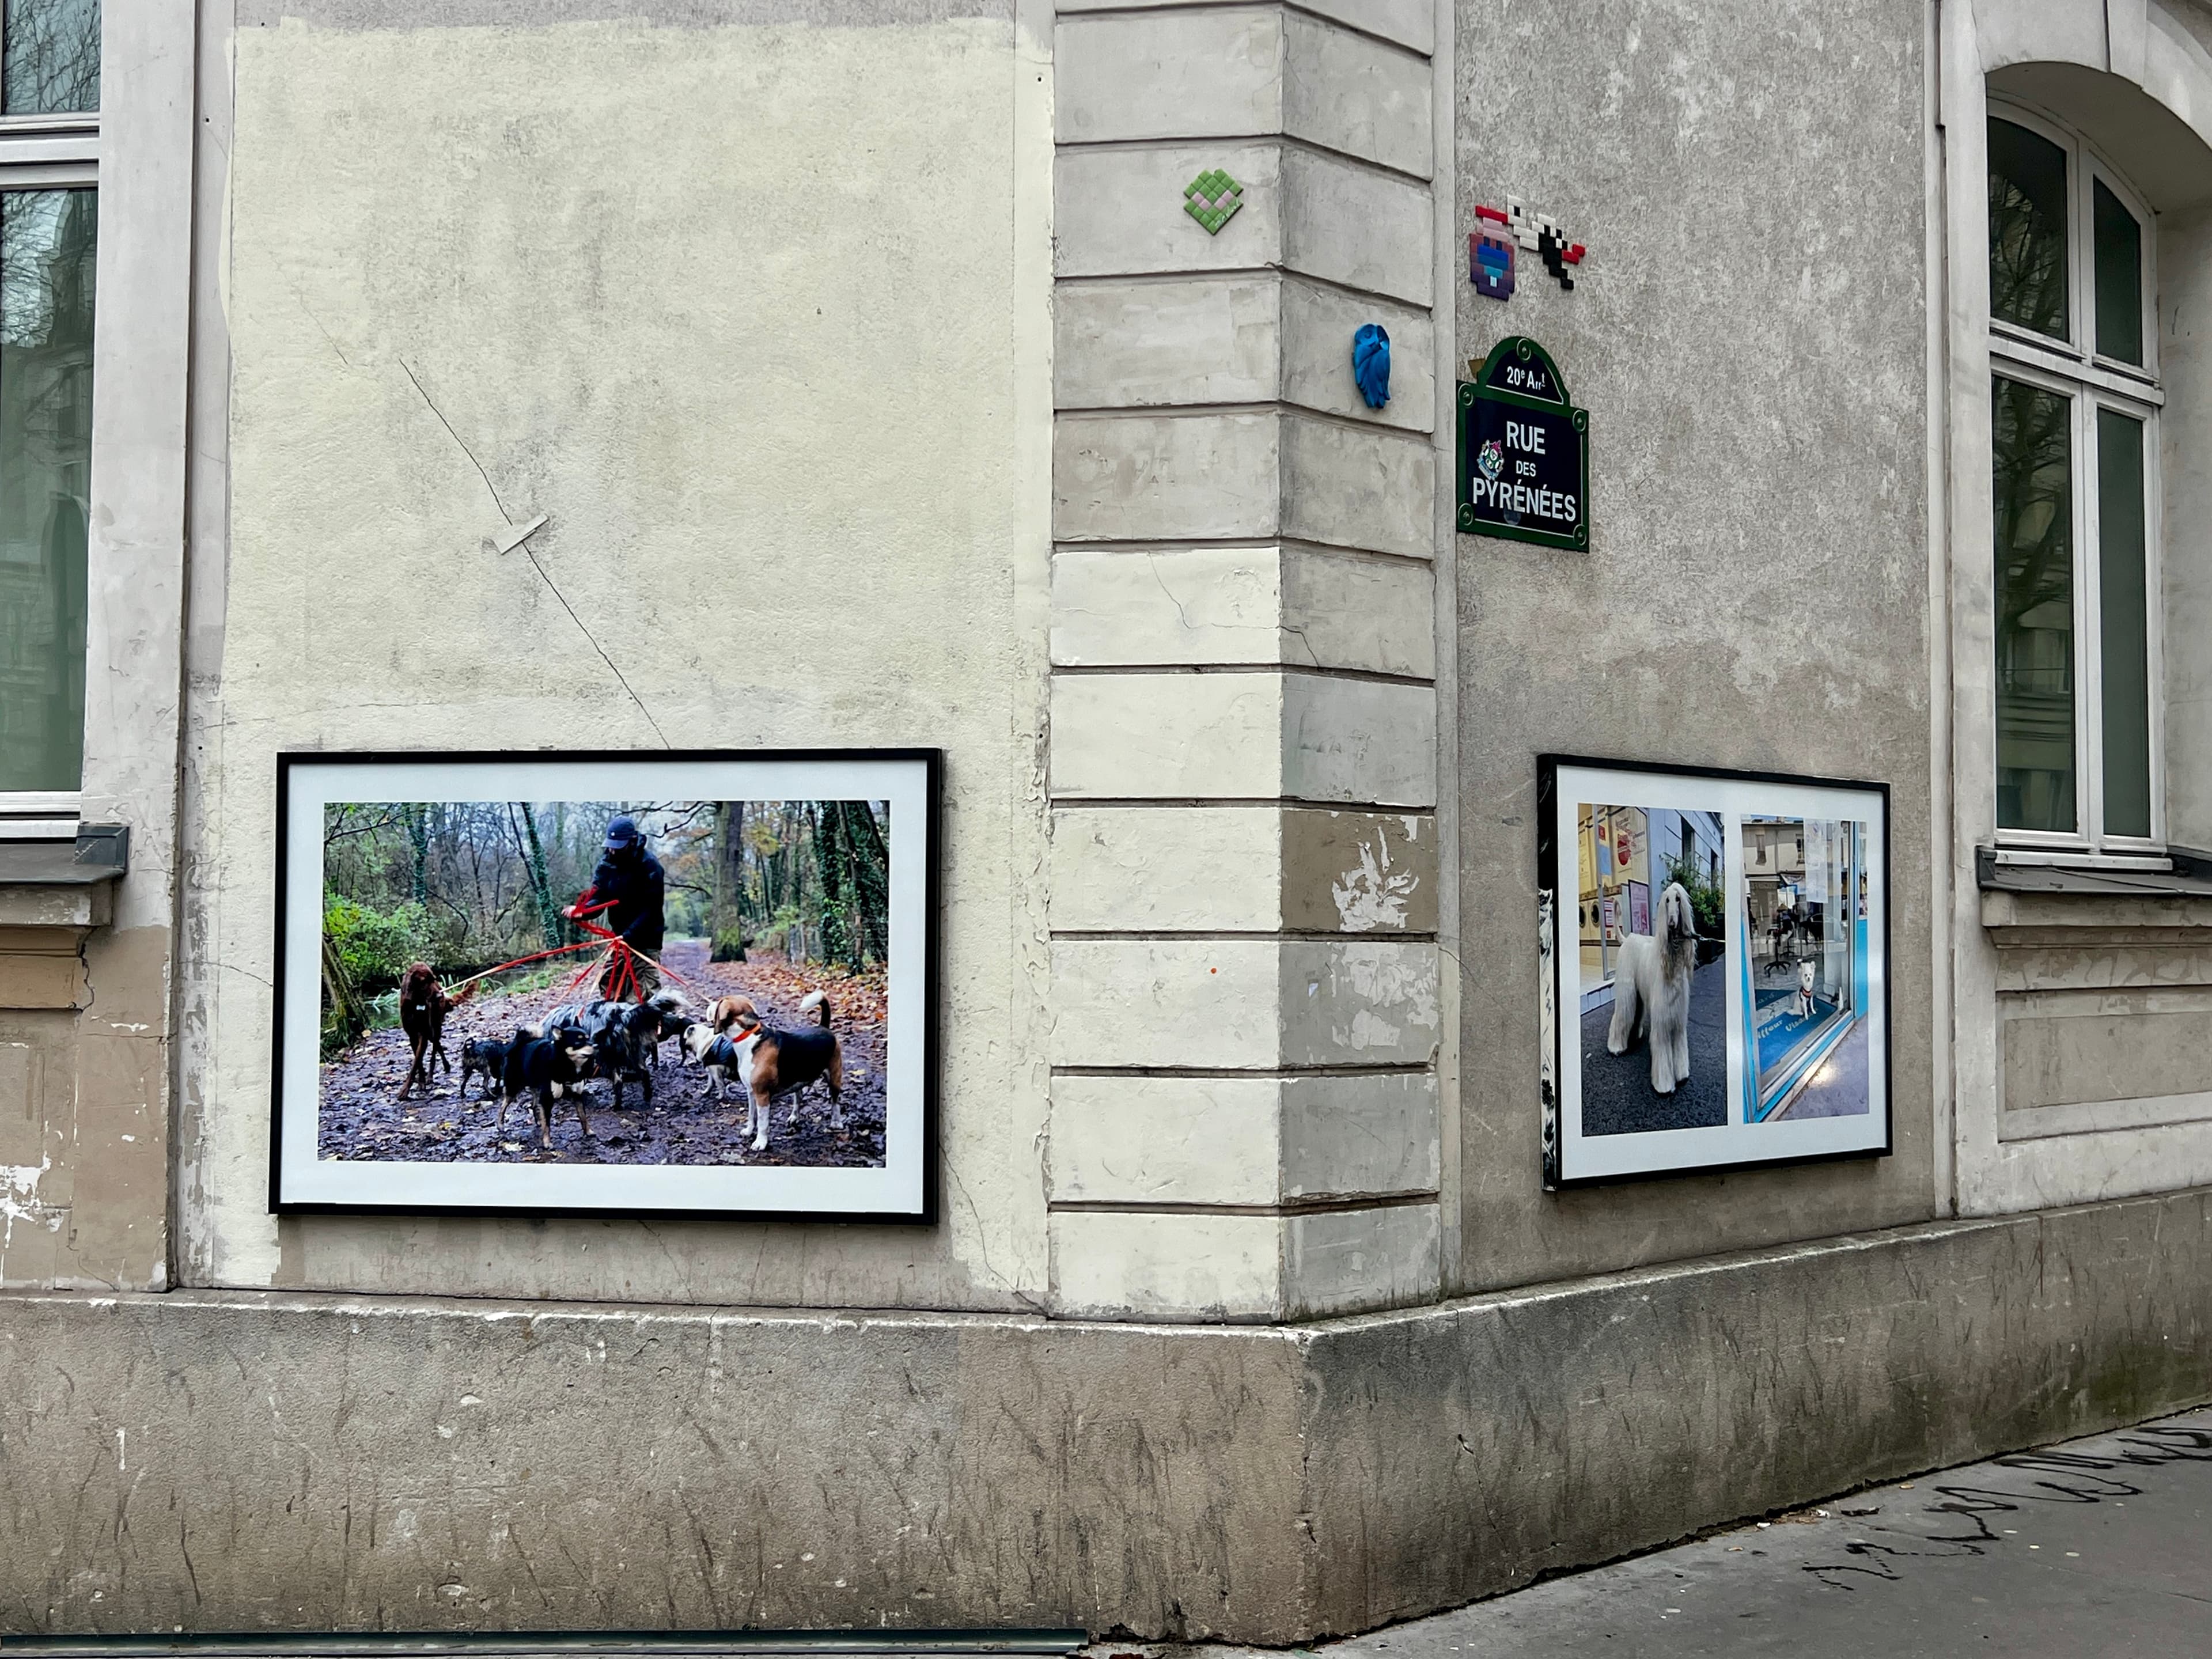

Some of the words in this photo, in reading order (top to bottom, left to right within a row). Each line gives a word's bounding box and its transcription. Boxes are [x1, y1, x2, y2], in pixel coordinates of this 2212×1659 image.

[1506, 421, 1546, 454] RUE
[1516, 460, 1537, 478] DES
[1473, 478, 1576, 522] PYRÉNÉES
